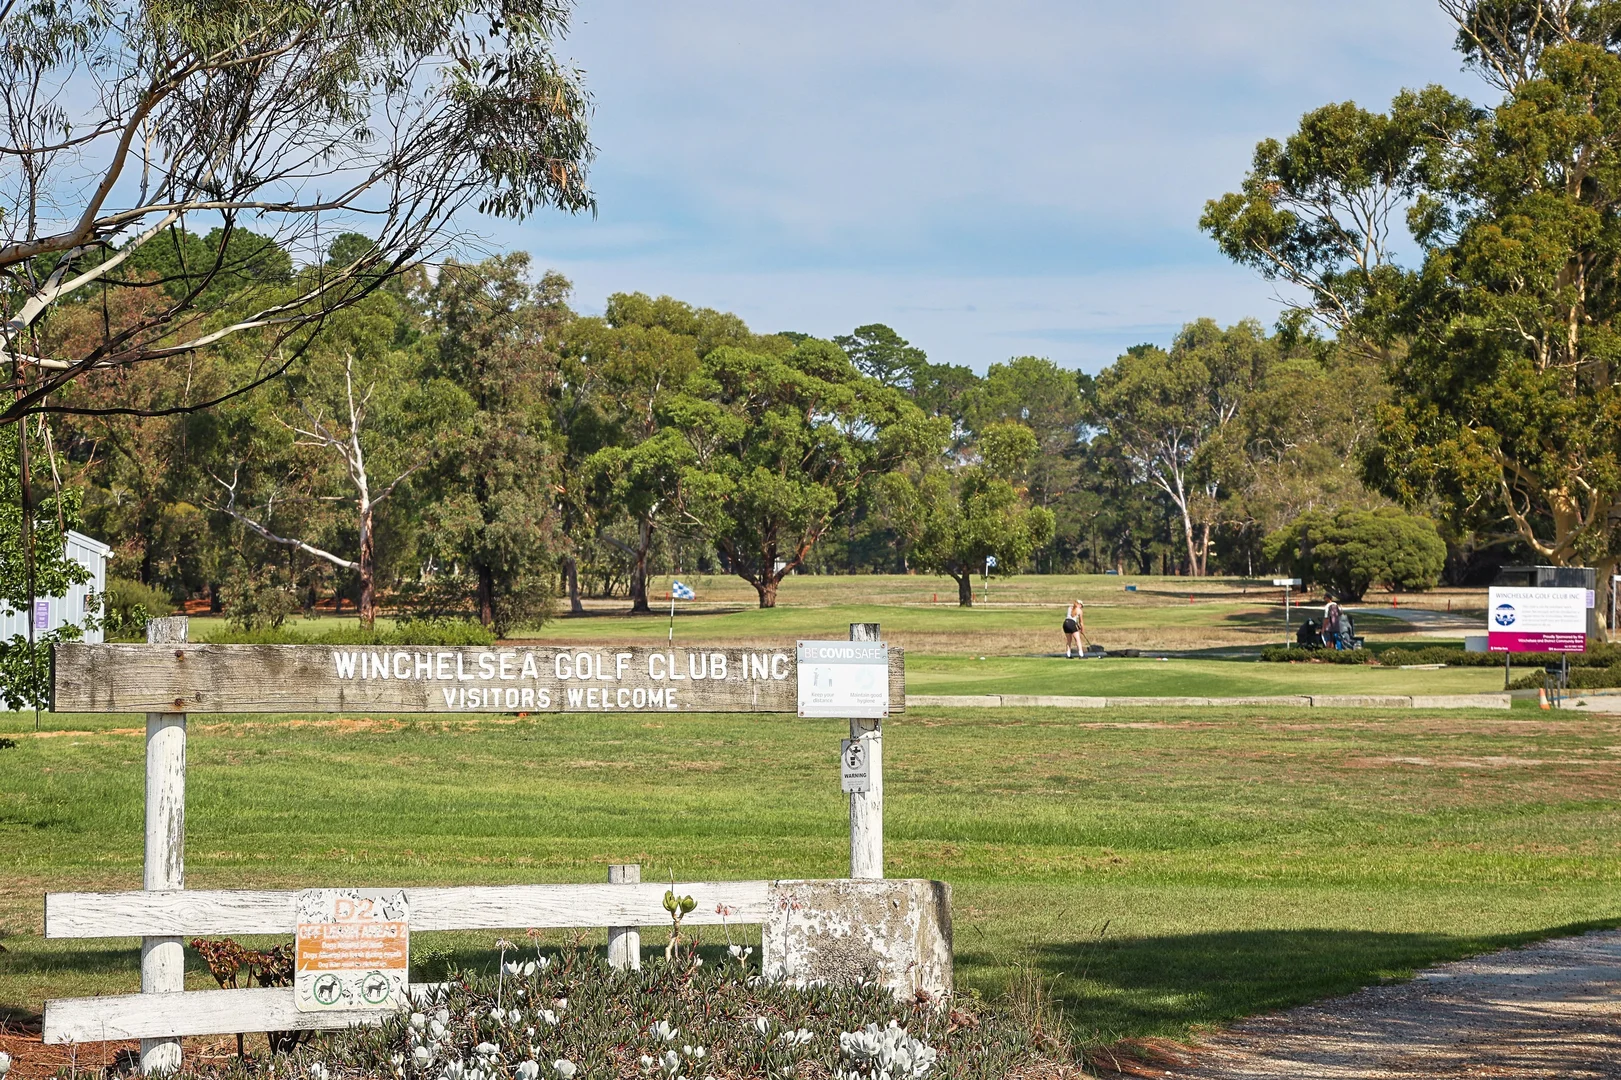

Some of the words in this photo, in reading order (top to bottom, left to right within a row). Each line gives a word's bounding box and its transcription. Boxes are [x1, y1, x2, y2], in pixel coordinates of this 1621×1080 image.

[804, 647, 818, 659] BE
[333, 651, 539, 681] WINCHELSEA
[554, 652, 633, 681] GOLF
[648, 652, 728, 681] CLUB
[741, 652, 789, 681] INC
[442, 687, 551, 709] VISITORS
[567, 687, 678, 709] WELCOME
